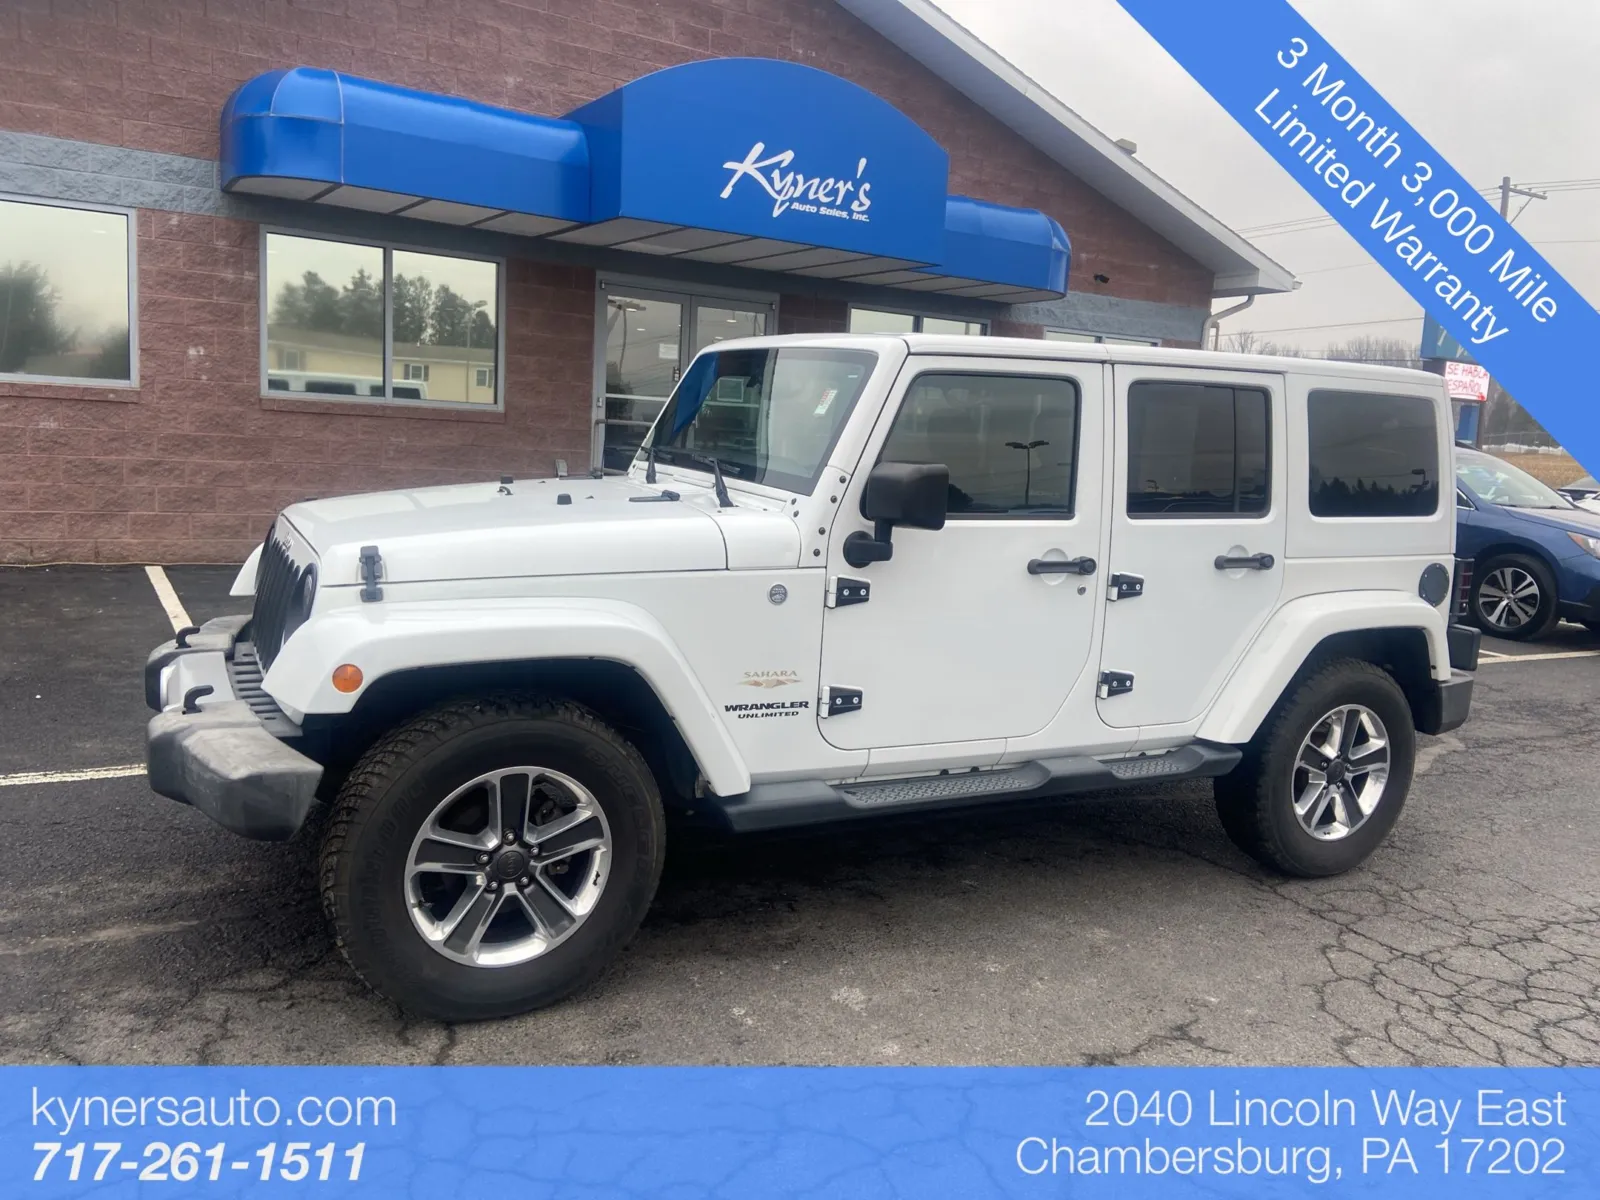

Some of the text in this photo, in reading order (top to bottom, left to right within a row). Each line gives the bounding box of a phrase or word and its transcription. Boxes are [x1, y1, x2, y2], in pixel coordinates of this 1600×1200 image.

[720, 142, 871, 217] Kyner's
[791, 202, 870, 222] Auto Sales, Inc.
[1448, 364, 1489, 380] SE HABLA
[744, 670, 797, 678] SAHARA
[724, 701, 809, 712] WRANGLER
[737, 711, 799, 719] UNLIMITED
